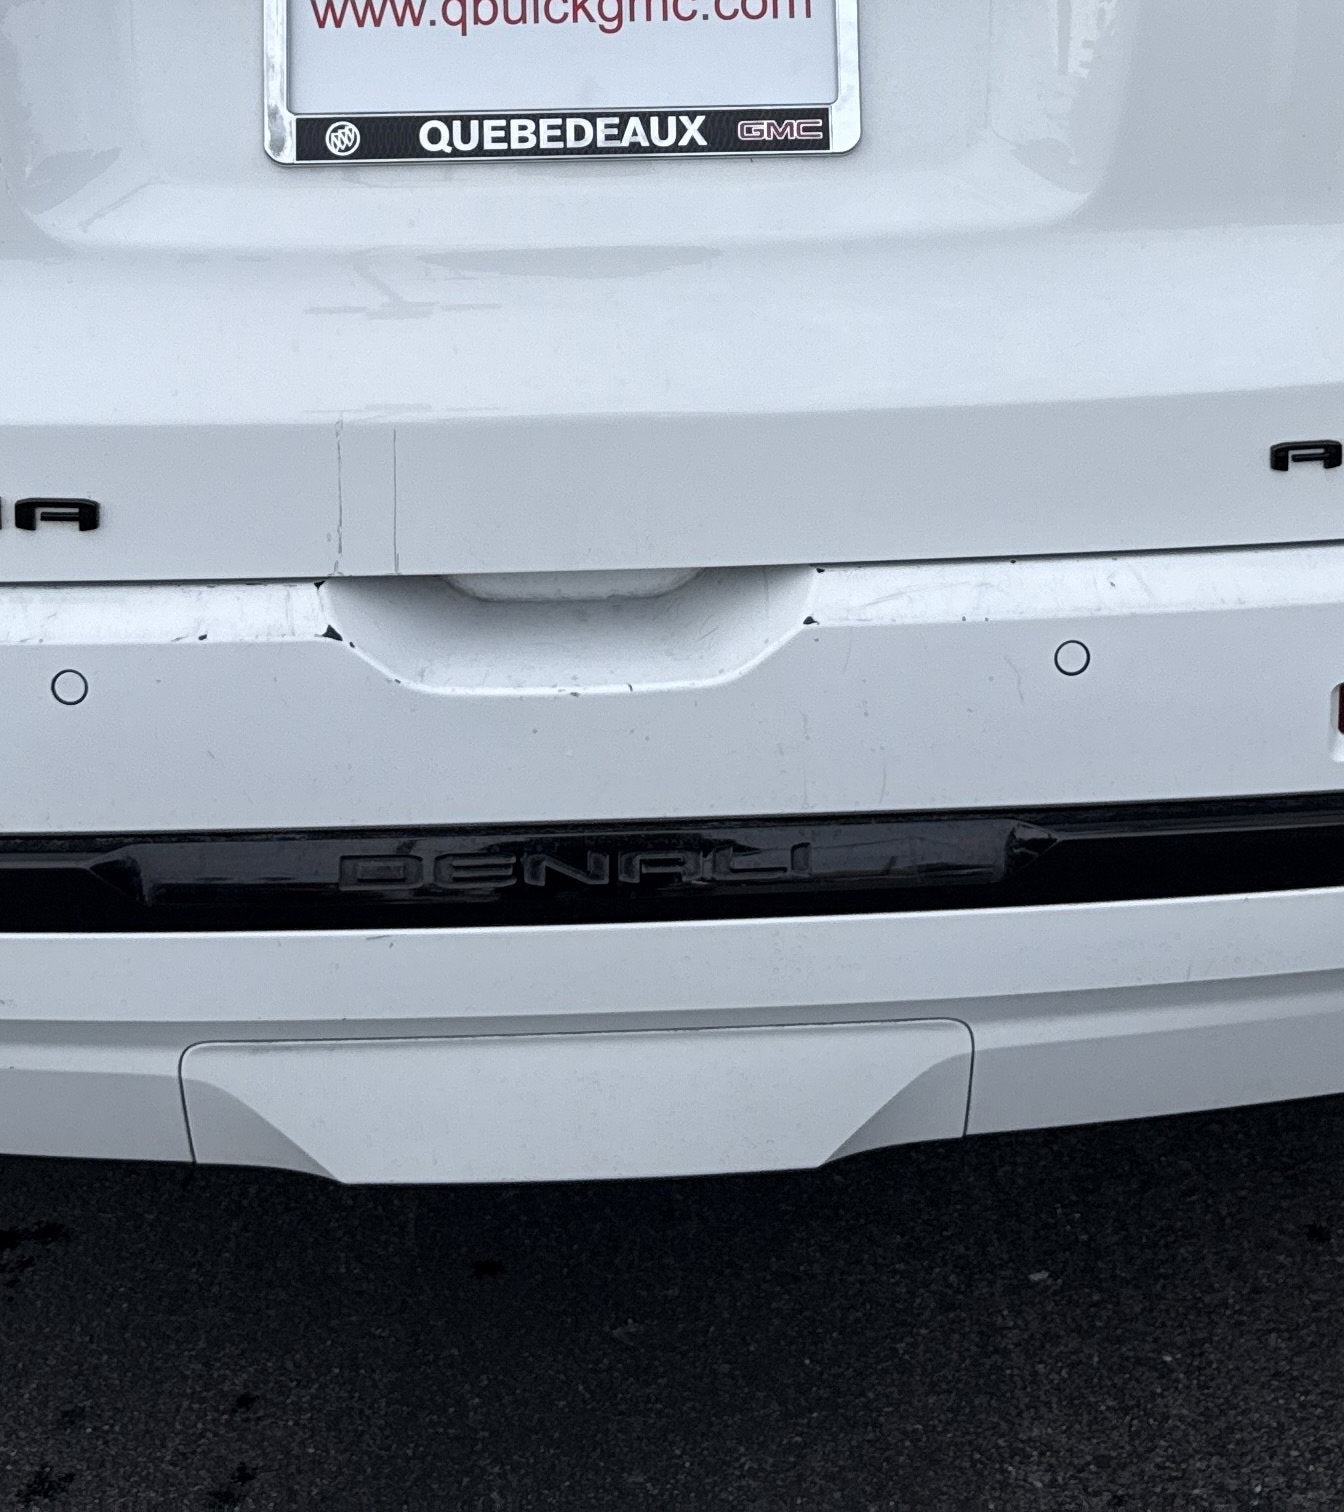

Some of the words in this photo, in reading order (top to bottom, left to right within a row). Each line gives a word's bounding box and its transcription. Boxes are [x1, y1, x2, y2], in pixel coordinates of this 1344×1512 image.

[418, 114, 708, 154] QUEBEDEAUX
[737, 118, 824, 141] GMC
[338, 841, 812, 891] DENALI
